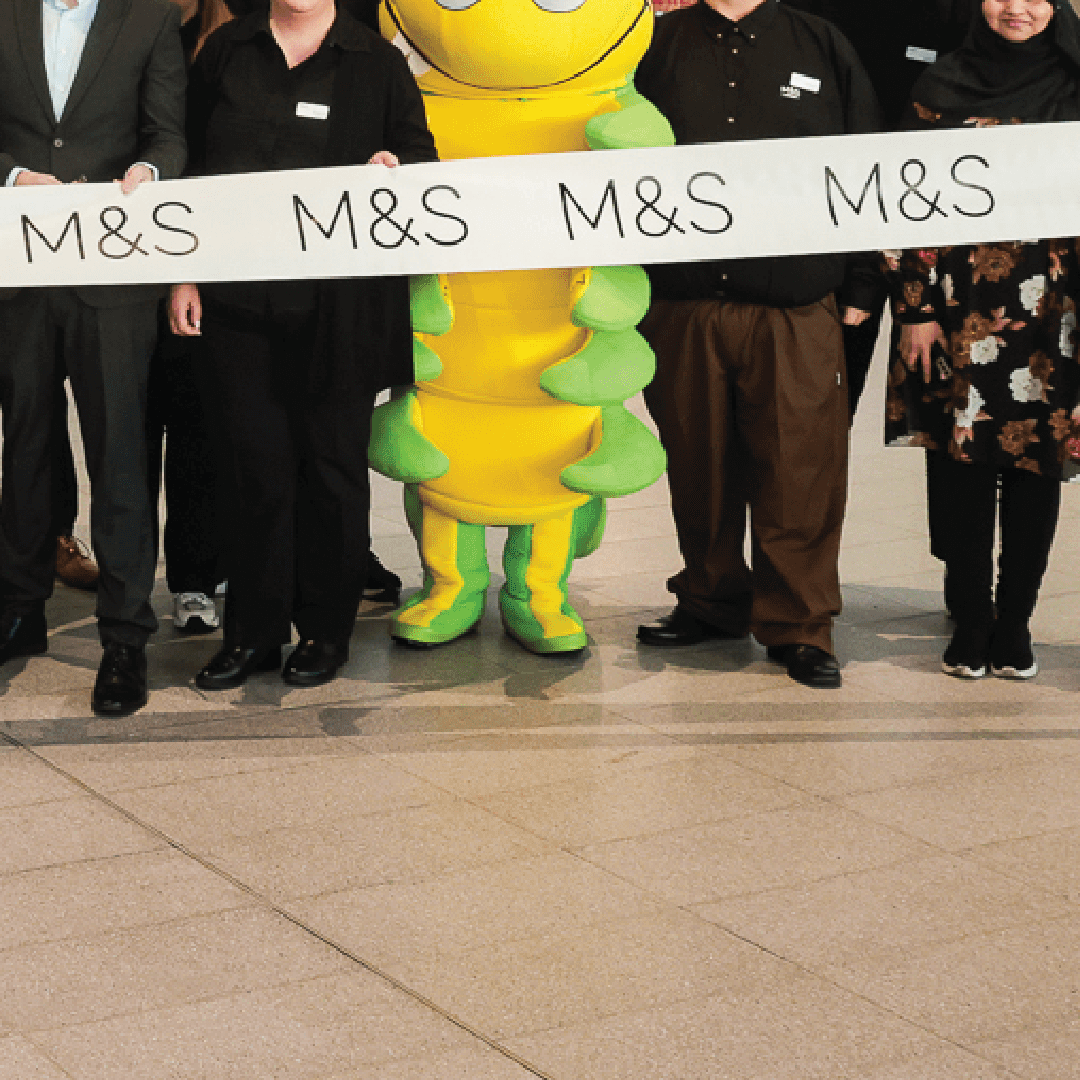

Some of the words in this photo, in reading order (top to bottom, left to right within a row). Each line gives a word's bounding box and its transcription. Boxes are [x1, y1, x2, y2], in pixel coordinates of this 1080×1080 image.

[20, 201, 199, 264] M&S
[292, 184, 469, 252] M&S
[558, 171, 733, 241] M&S
[824, 154, 995, 226] M&S
